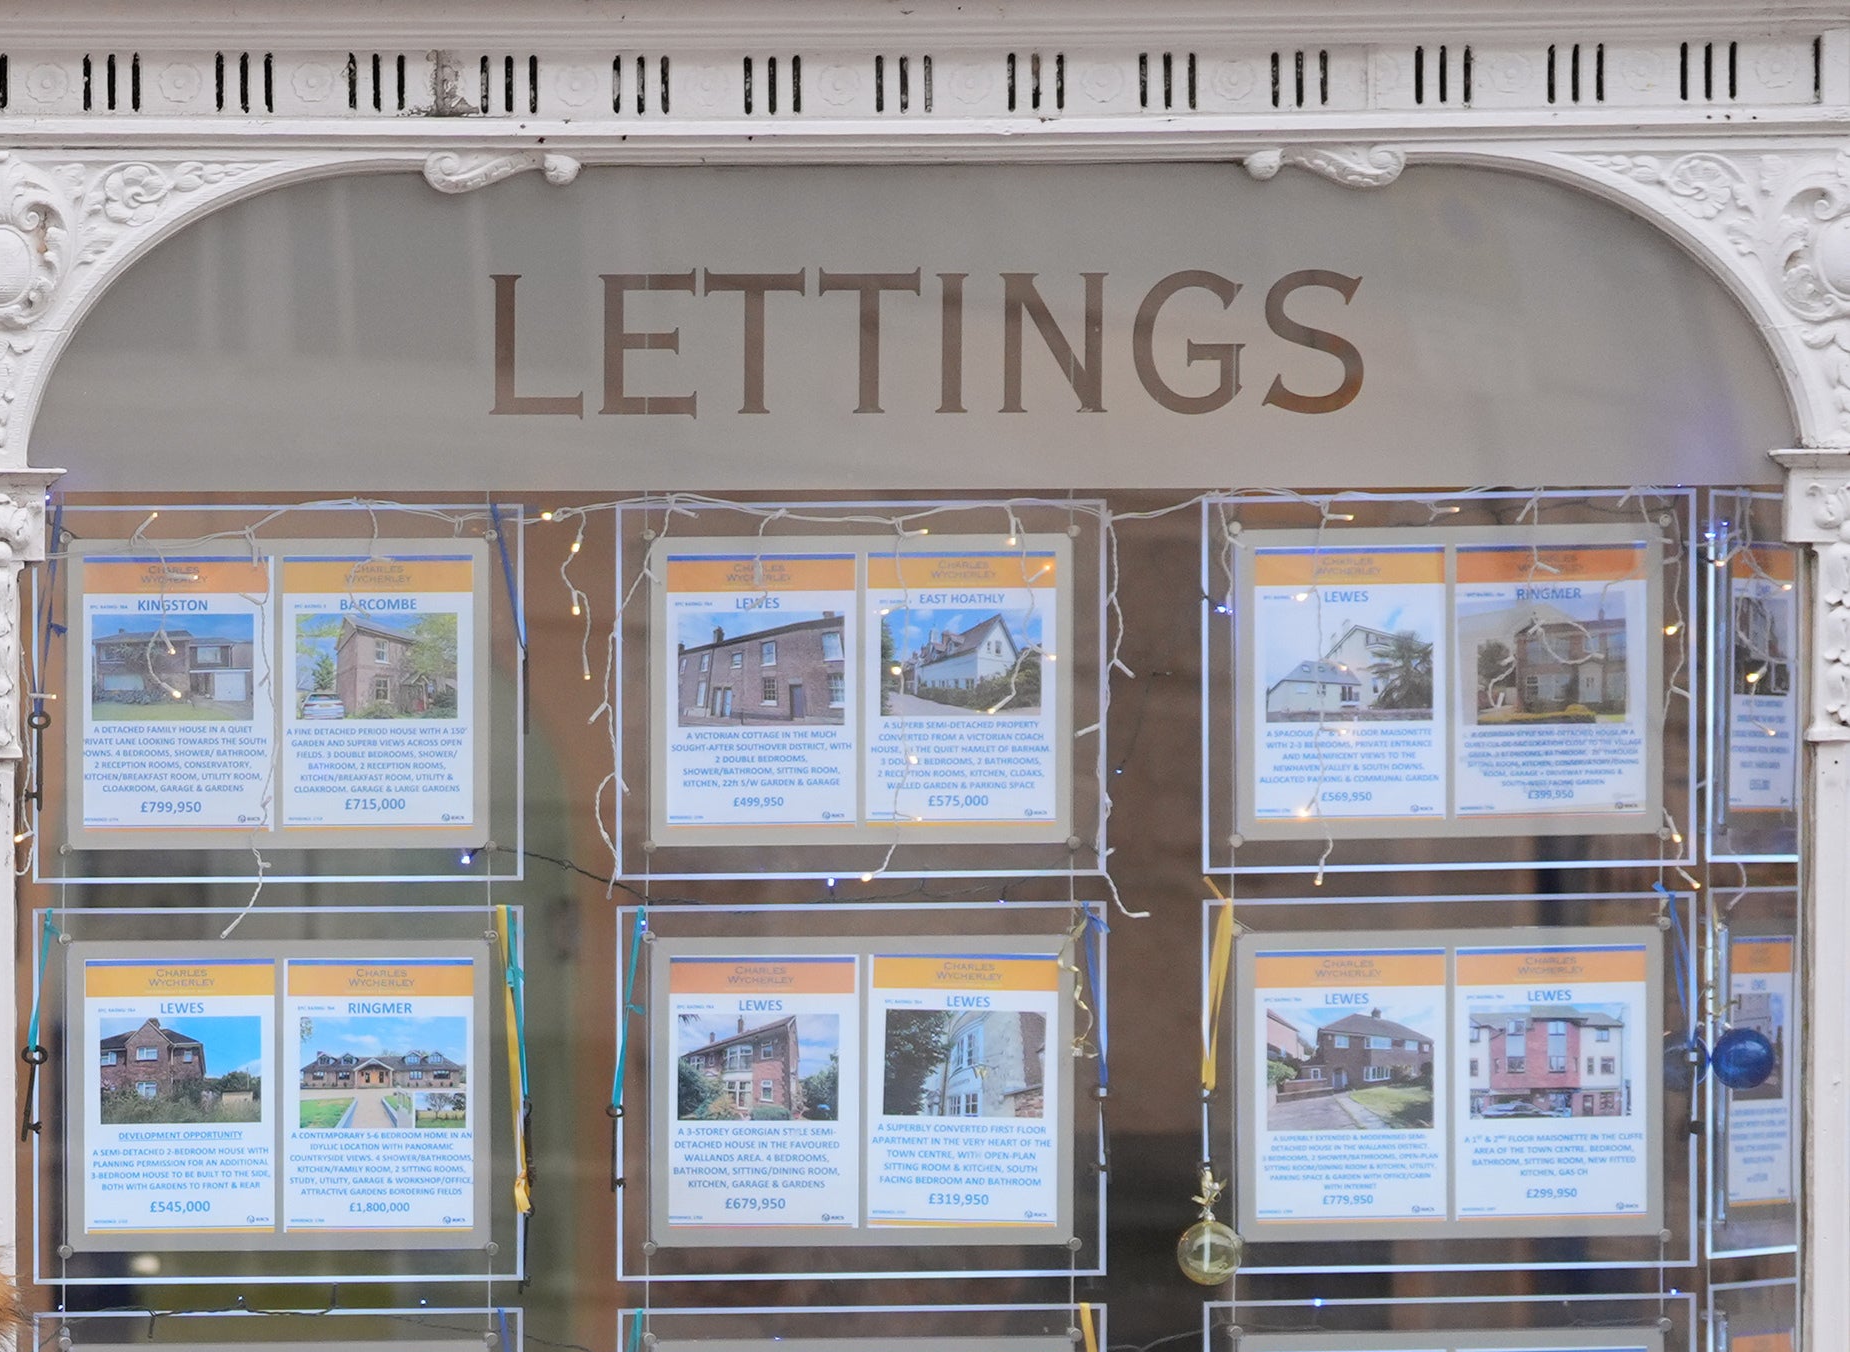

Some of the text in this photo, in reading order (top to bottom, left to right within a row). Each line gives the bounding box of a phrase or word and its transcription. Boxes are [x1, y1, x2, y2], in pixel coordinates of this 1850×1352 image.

[488, 267, 1365, 418] LETTINGS
[920, 594, 1004, 604] EAST HOATHLY
[1325, 591, 1368, 602] LEWES
[1514, 588, 1582, 602] RINGMER
[138, 600, 207, 611] KINGSTON
[340, 599, 416, 610] BARCOMBE
[929, 795, 988, 806] £575,000
[1322, 792, 1372, 801] £569,950
[141, 802, 201, 812] £799,950
[345, 799, 405, 809] £715,000
[734, 797, 784, 807] £499,950
[156, 968, 211, 977] CHARLES
[356, 969, 407, 977] CHARLES
[349, 979, 414, 987] WYCHERLEY
[1325, 994, 1369, 1004] LEWES
[1528, 990, 1571, 1001] LEWES
[739, 1000, 782, 1011] LEWES
[947, 996, 990, 1007] LEWES
[161, 1003, 204, 1014] LEWES
[349, 1003, 412, 1013] RINGMER
[119, 1131, 242, 1141] DEVELOPMENT OPPORTUNITY
[1527, 1188, 1577, 1198] £299,950
[726, 1198, 785, 1209] £679,950
[929, 1194, 989, 1205] £319,950
[1323, 1195, 1373, 1204] £779,950
[150, 1201, 210, 1212] £545,000
[350, 1203, 409, 1212] £1,800,000
